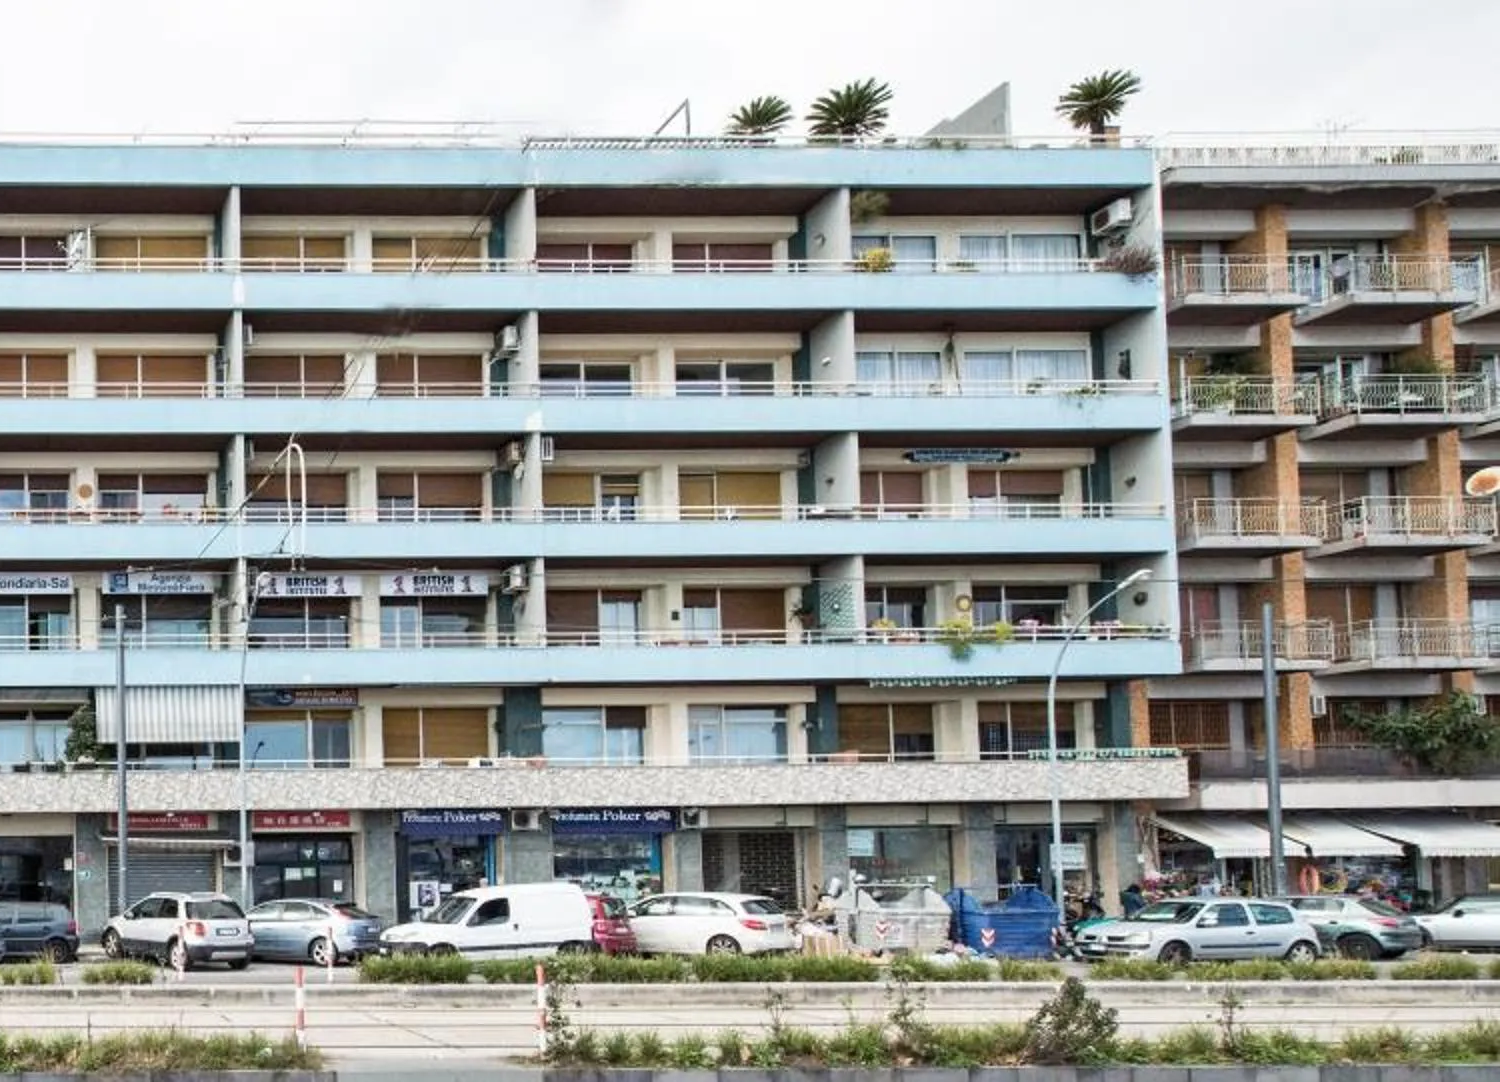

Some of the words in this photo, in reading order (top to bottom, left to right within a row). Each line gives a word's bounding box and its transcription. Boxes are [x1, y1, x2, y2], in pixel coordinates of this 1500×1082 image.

[286, 577, 327, 586] BRITISH
[413, 575, 455, 585] BRITISH
[443, 810, 478, 822] Poker
[603, 810, 641, 821] Poker
